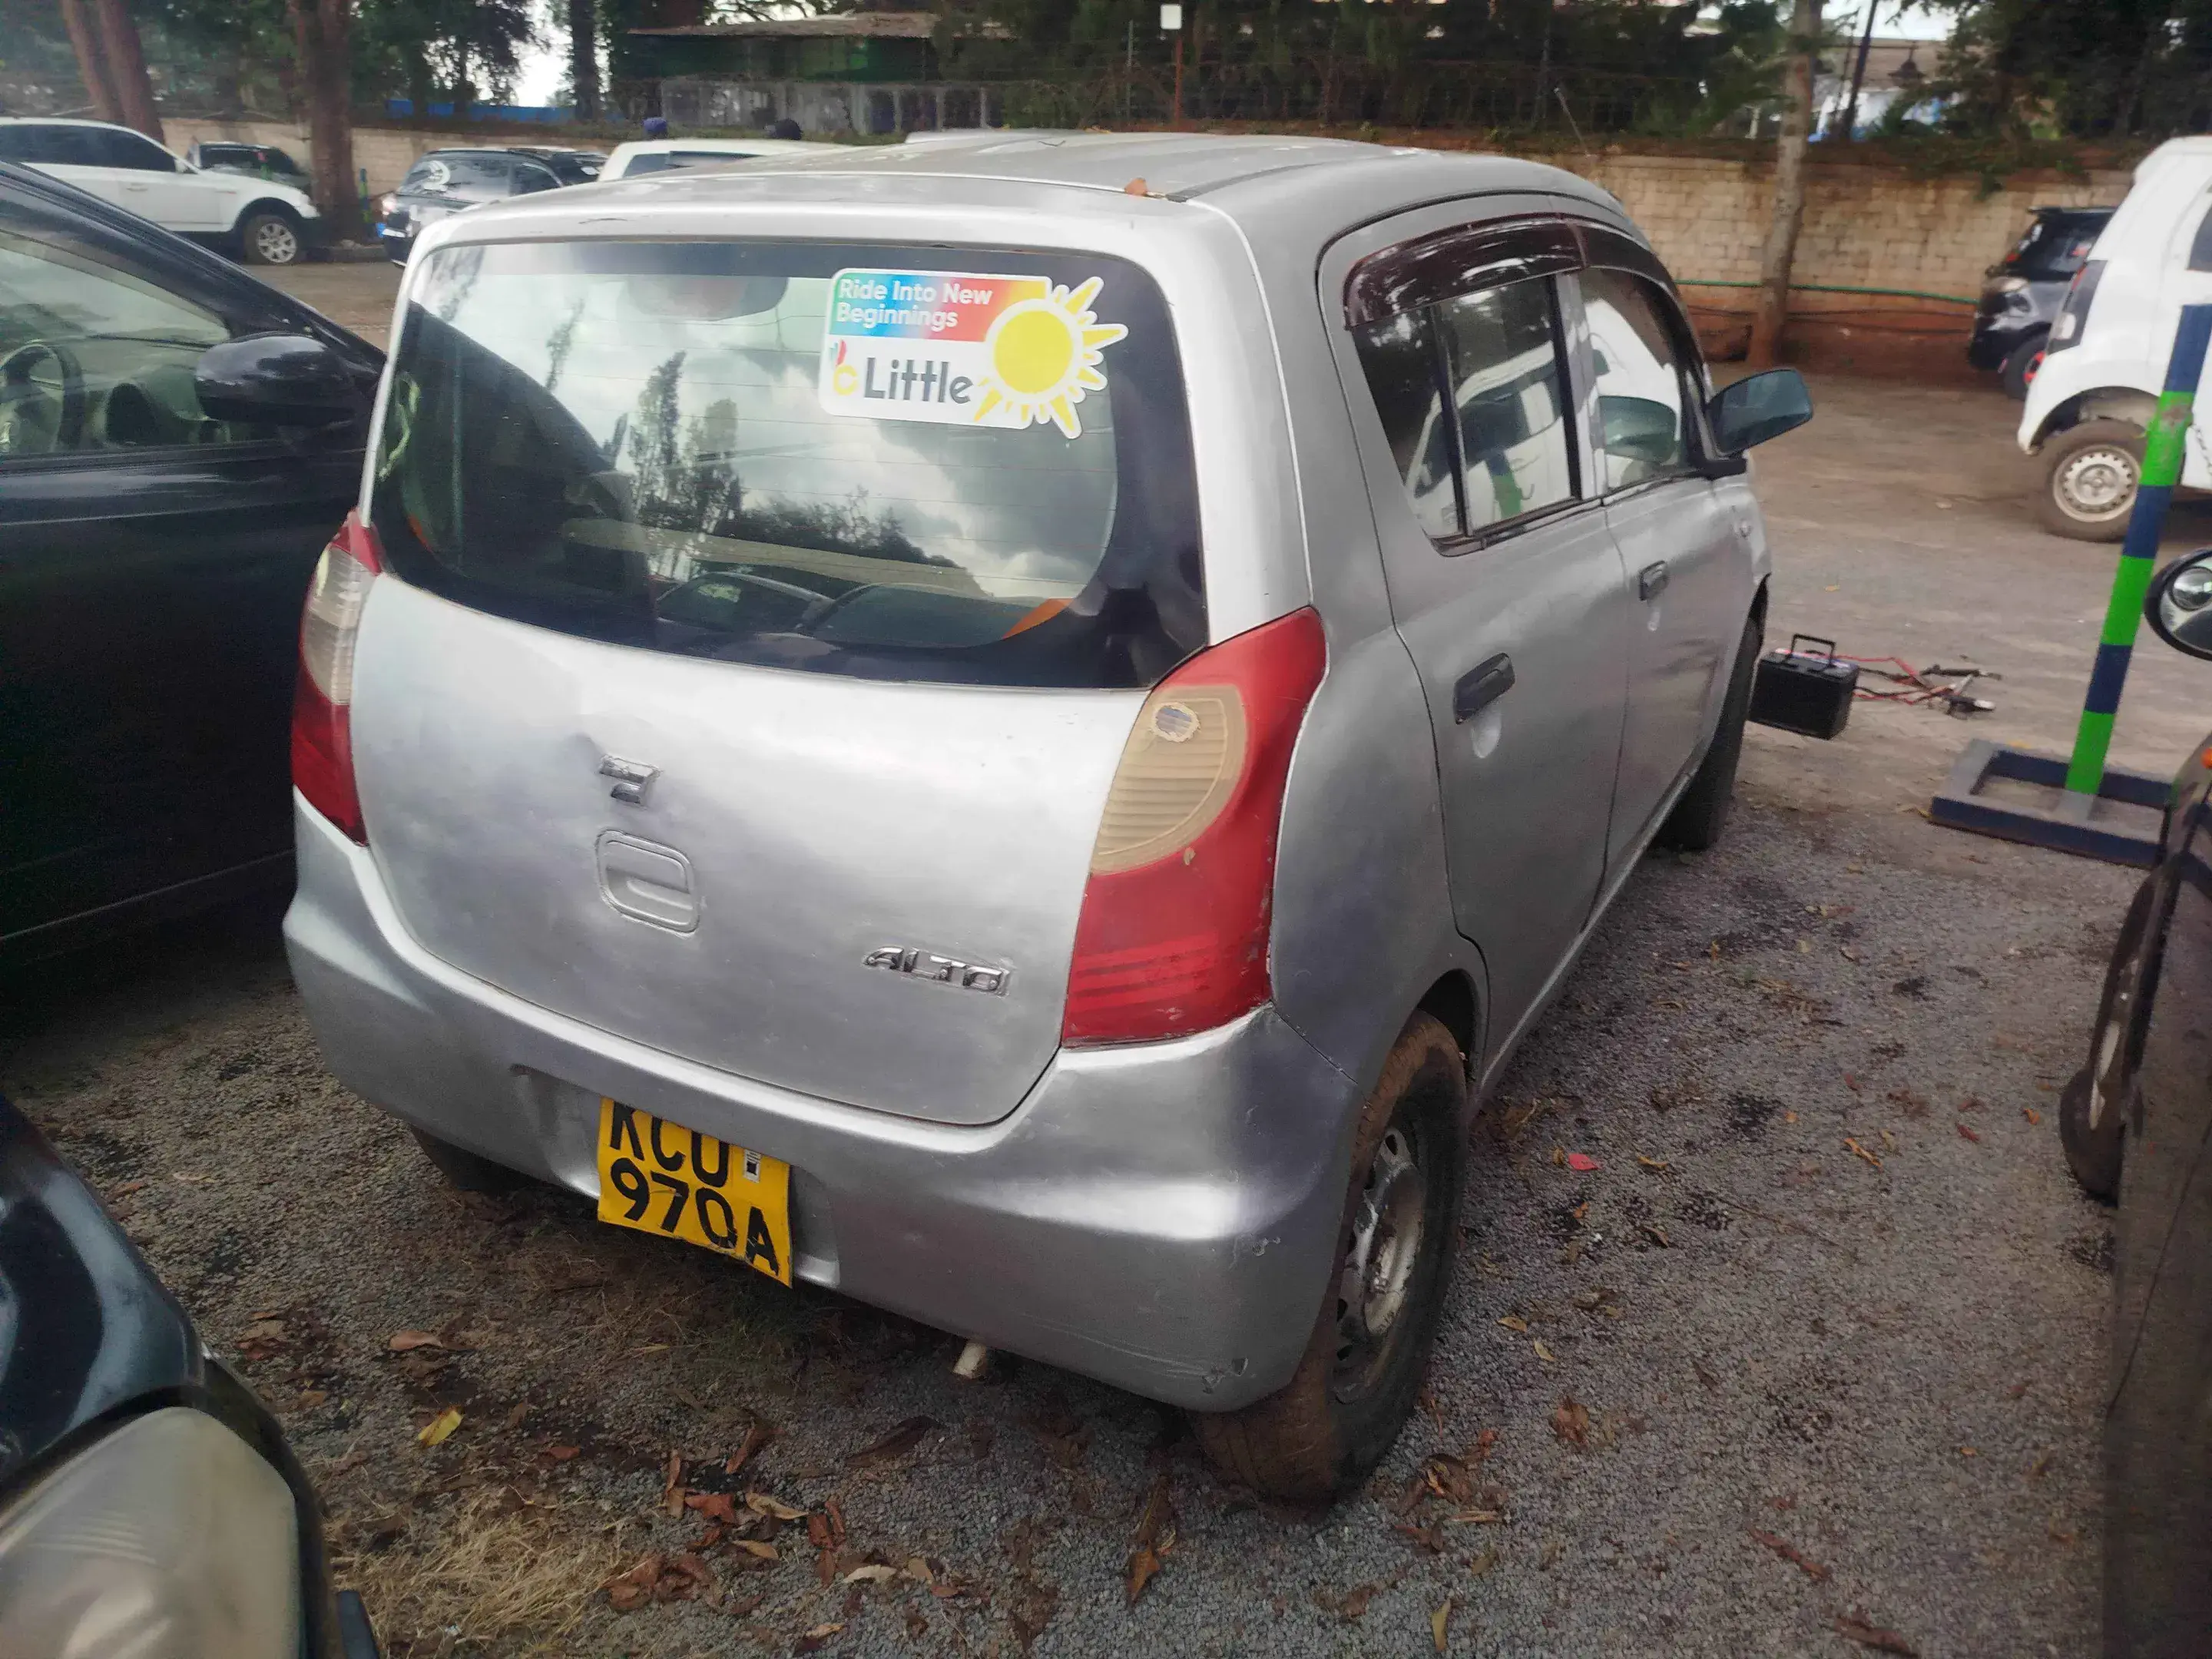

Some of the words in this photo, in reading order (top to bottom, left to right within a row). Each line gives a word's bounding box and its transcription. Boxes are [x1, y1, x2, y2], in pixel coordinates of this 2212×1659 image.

[839, 279, 888, 300] Ride
[892, 280, 937, 303] Into
[942, 283, 993, 305] New
[836, 302, 959, 332] Beginnings
[863, 356, 973, 404] Little
[610, 1101, 730, 1187] KCU
[610, 1157, 779, 1276] 970A
